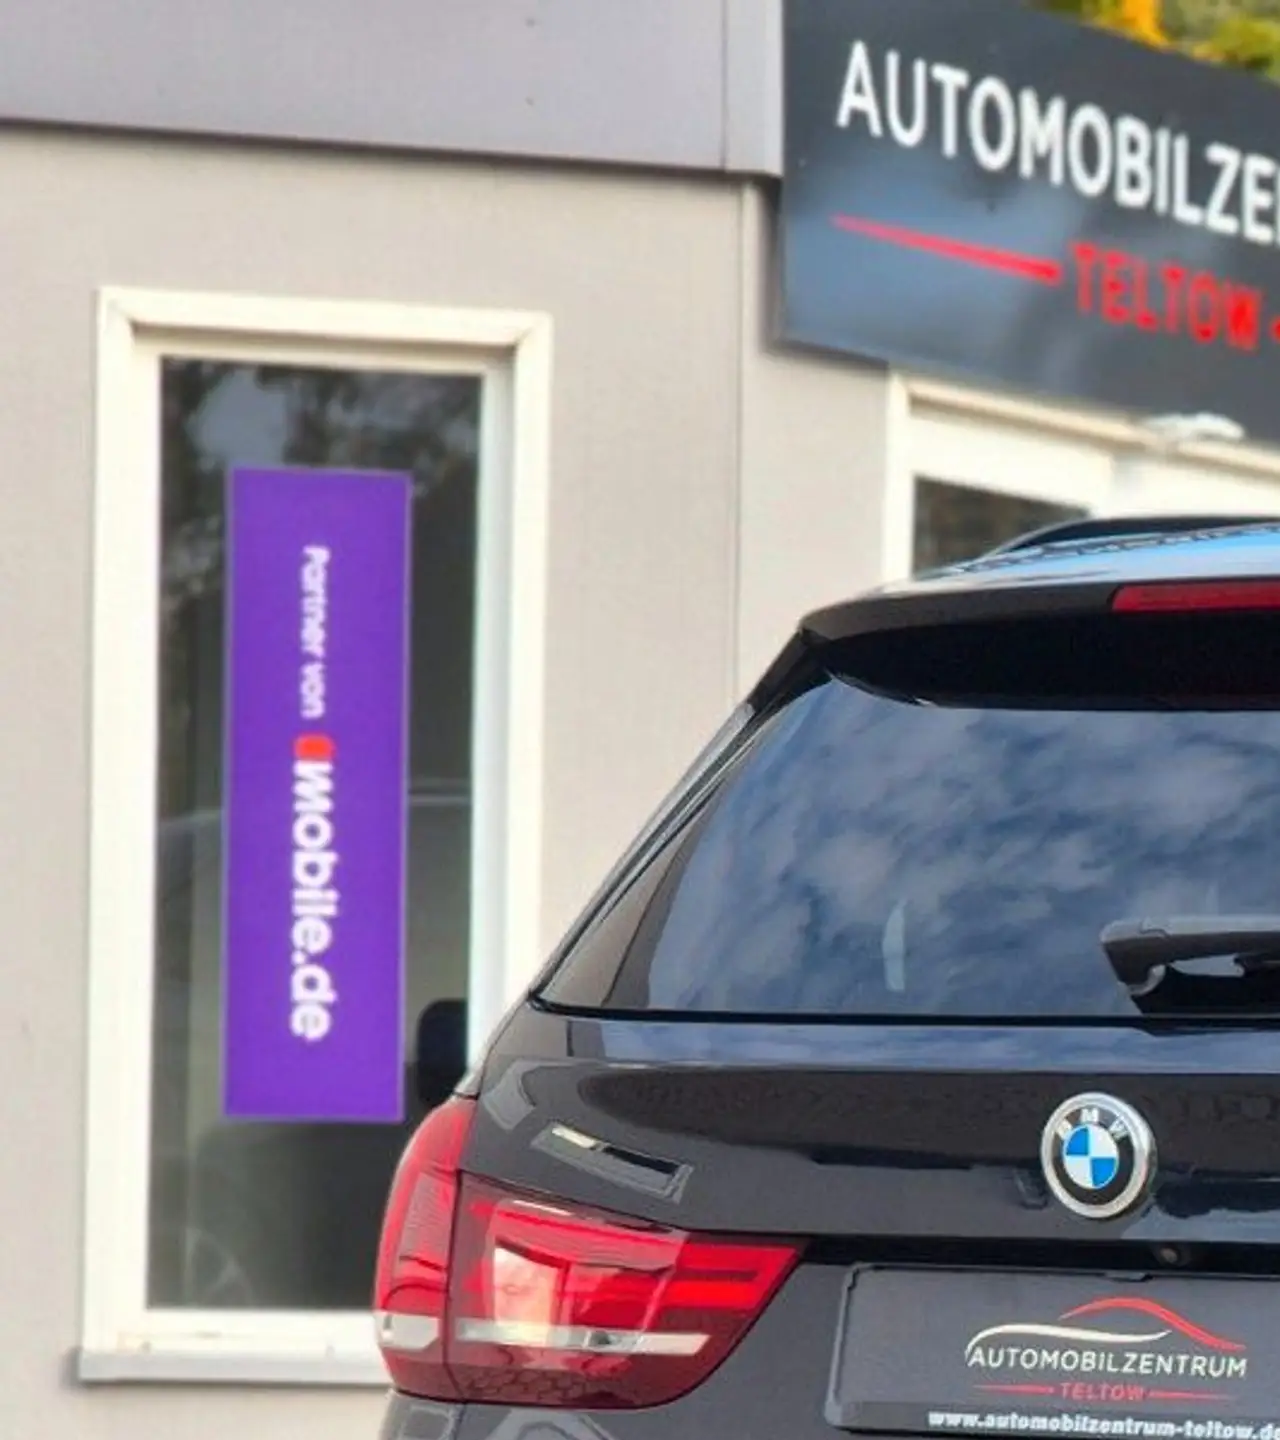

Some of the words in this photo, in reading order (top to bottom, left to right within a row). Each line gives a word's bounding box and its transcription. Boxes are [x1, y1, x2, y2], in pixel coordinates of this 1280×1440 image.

[1071, 242, 1264, 350] TELTOW
[301, 545, 330, 658] Partner
[300, 661, 325, 719] von
[1056, 1107, 1129, 1141] BMW
[967, 1346, 1248, 1378] AUTOMOBILZENTRUM
[1060, 1381, 1145, 1402] TELTOW
